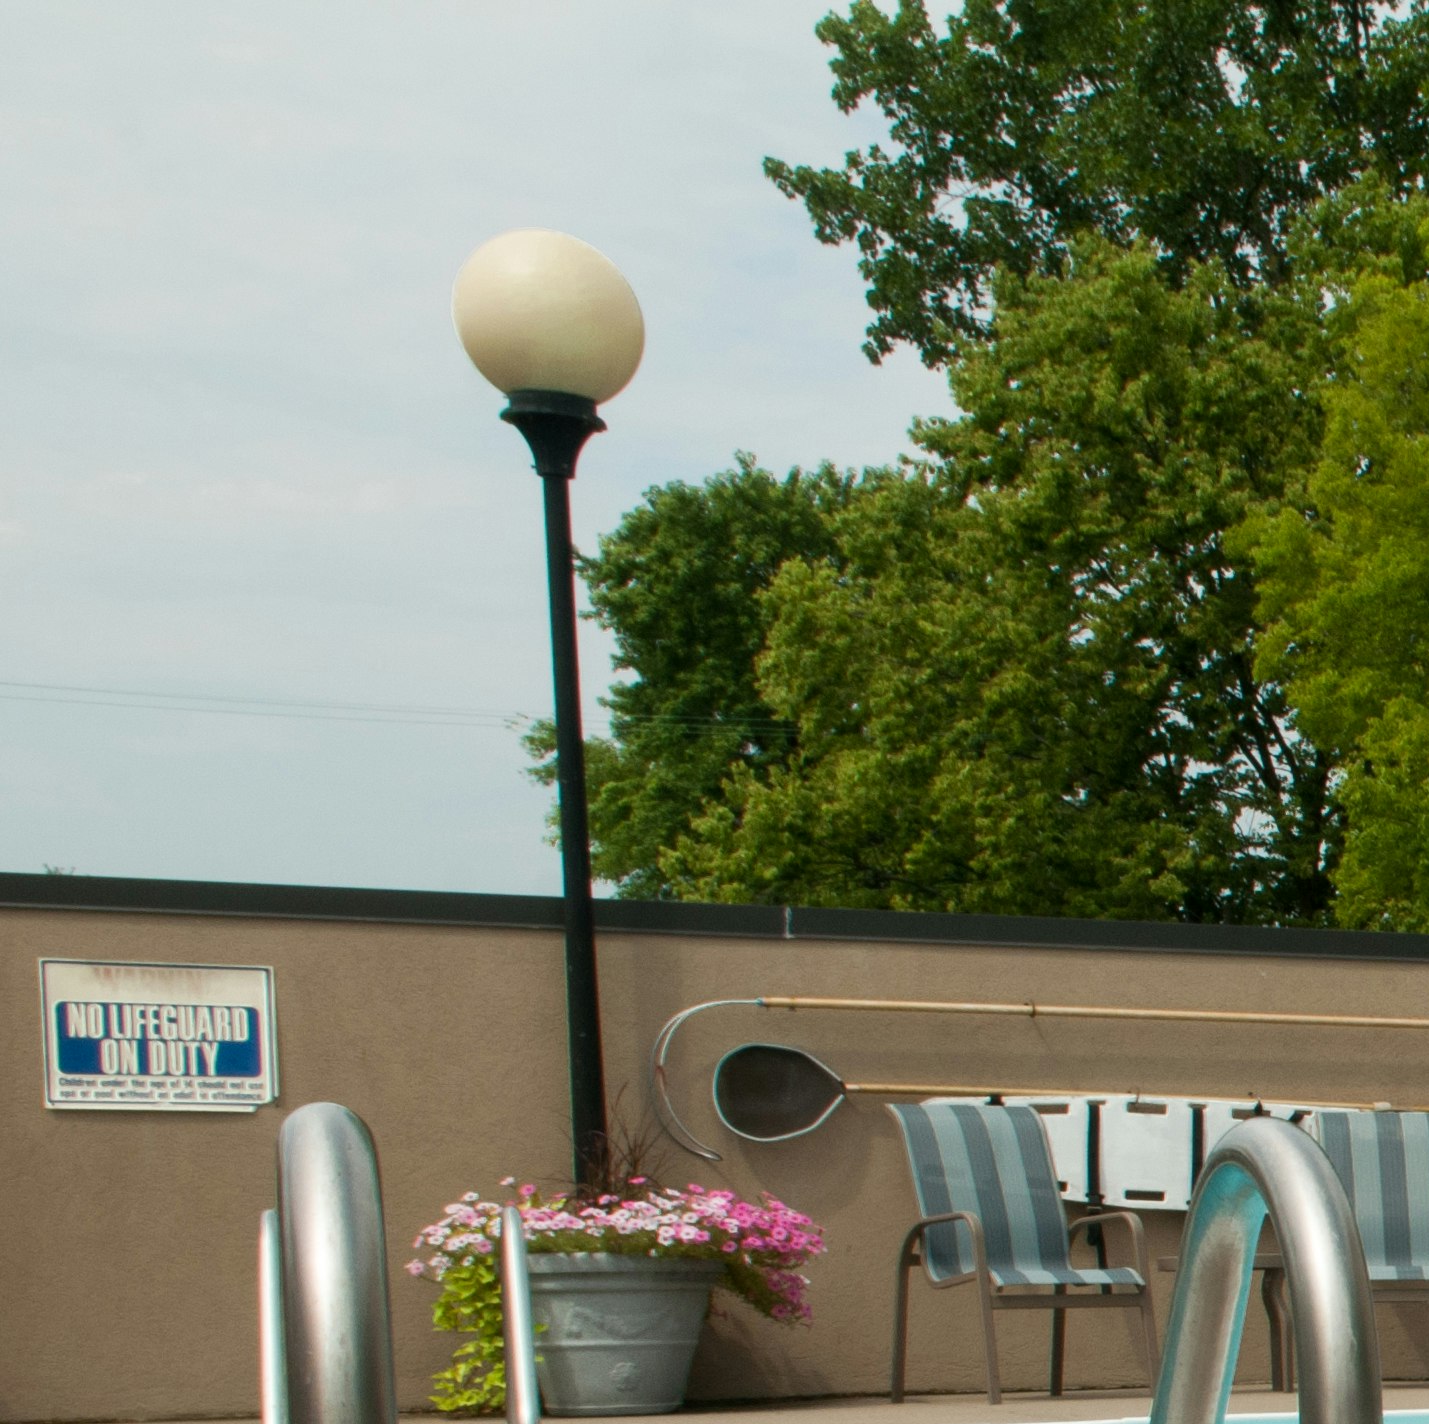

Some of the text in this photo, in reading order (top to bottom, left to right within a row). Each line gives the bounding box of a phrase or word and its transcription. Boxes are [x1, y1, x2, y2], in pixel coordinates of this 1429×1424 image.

[66, 1003, 249, 1042] NO LIFEGUARD
[100, 1039, 219, 1076] ON DUTY
